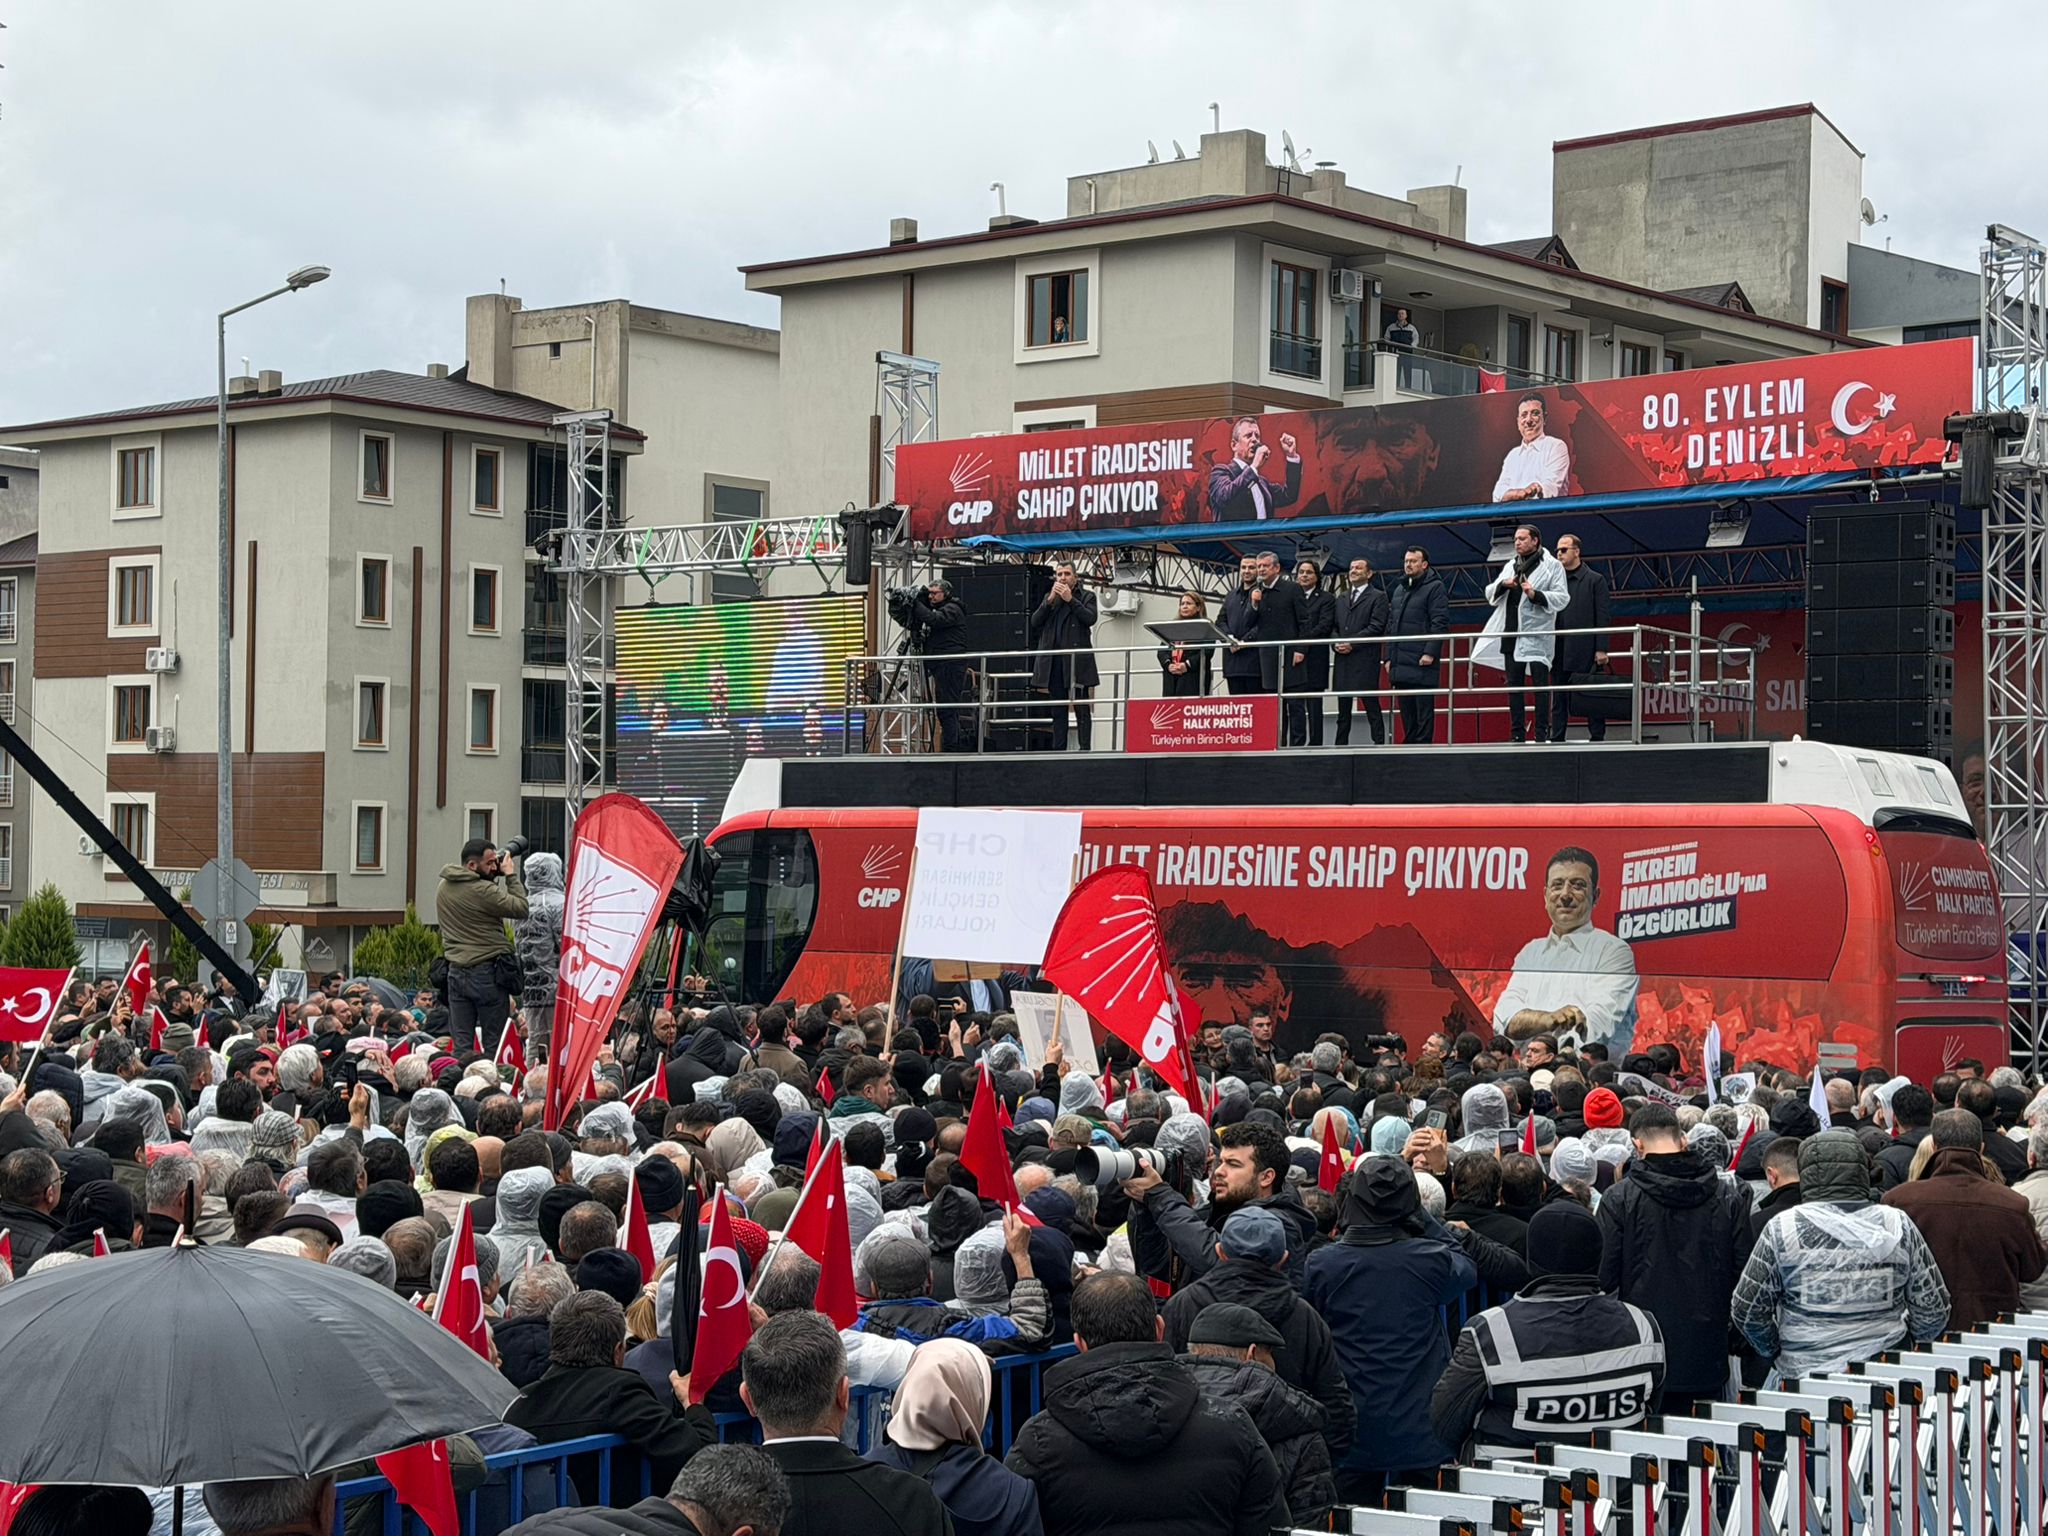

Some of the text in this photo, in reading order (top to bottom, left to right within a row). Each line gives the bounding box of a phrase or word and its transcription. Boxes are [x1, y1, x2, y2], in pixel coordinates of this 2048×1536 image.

[1643, 377, 1805, 430] 80. EYLEM
[947, 499, 993, 525] CHP
[1079, 480, 1159, 521] ÇIKIYOR
[1183, 701, 1254, 716] CUMHURİYET
[1183, 715, 1254, 730] HALK PARTİSİ
[1151, 732, 1253, 748] Türkiye'nin Birinci Partisi
[1403, 845, 1529, 897] ÇIKIYOR
[1621, 852, 1698, 885] EKREM
[1931, 864, 1991, 890] CUMHURİYET
[857, 887, 901, 908] CHP
[1935, 891, 1996, 916] HALK PARTİSİ
[1618, 901, 1732, 940] ÖZGÜRLÜK
